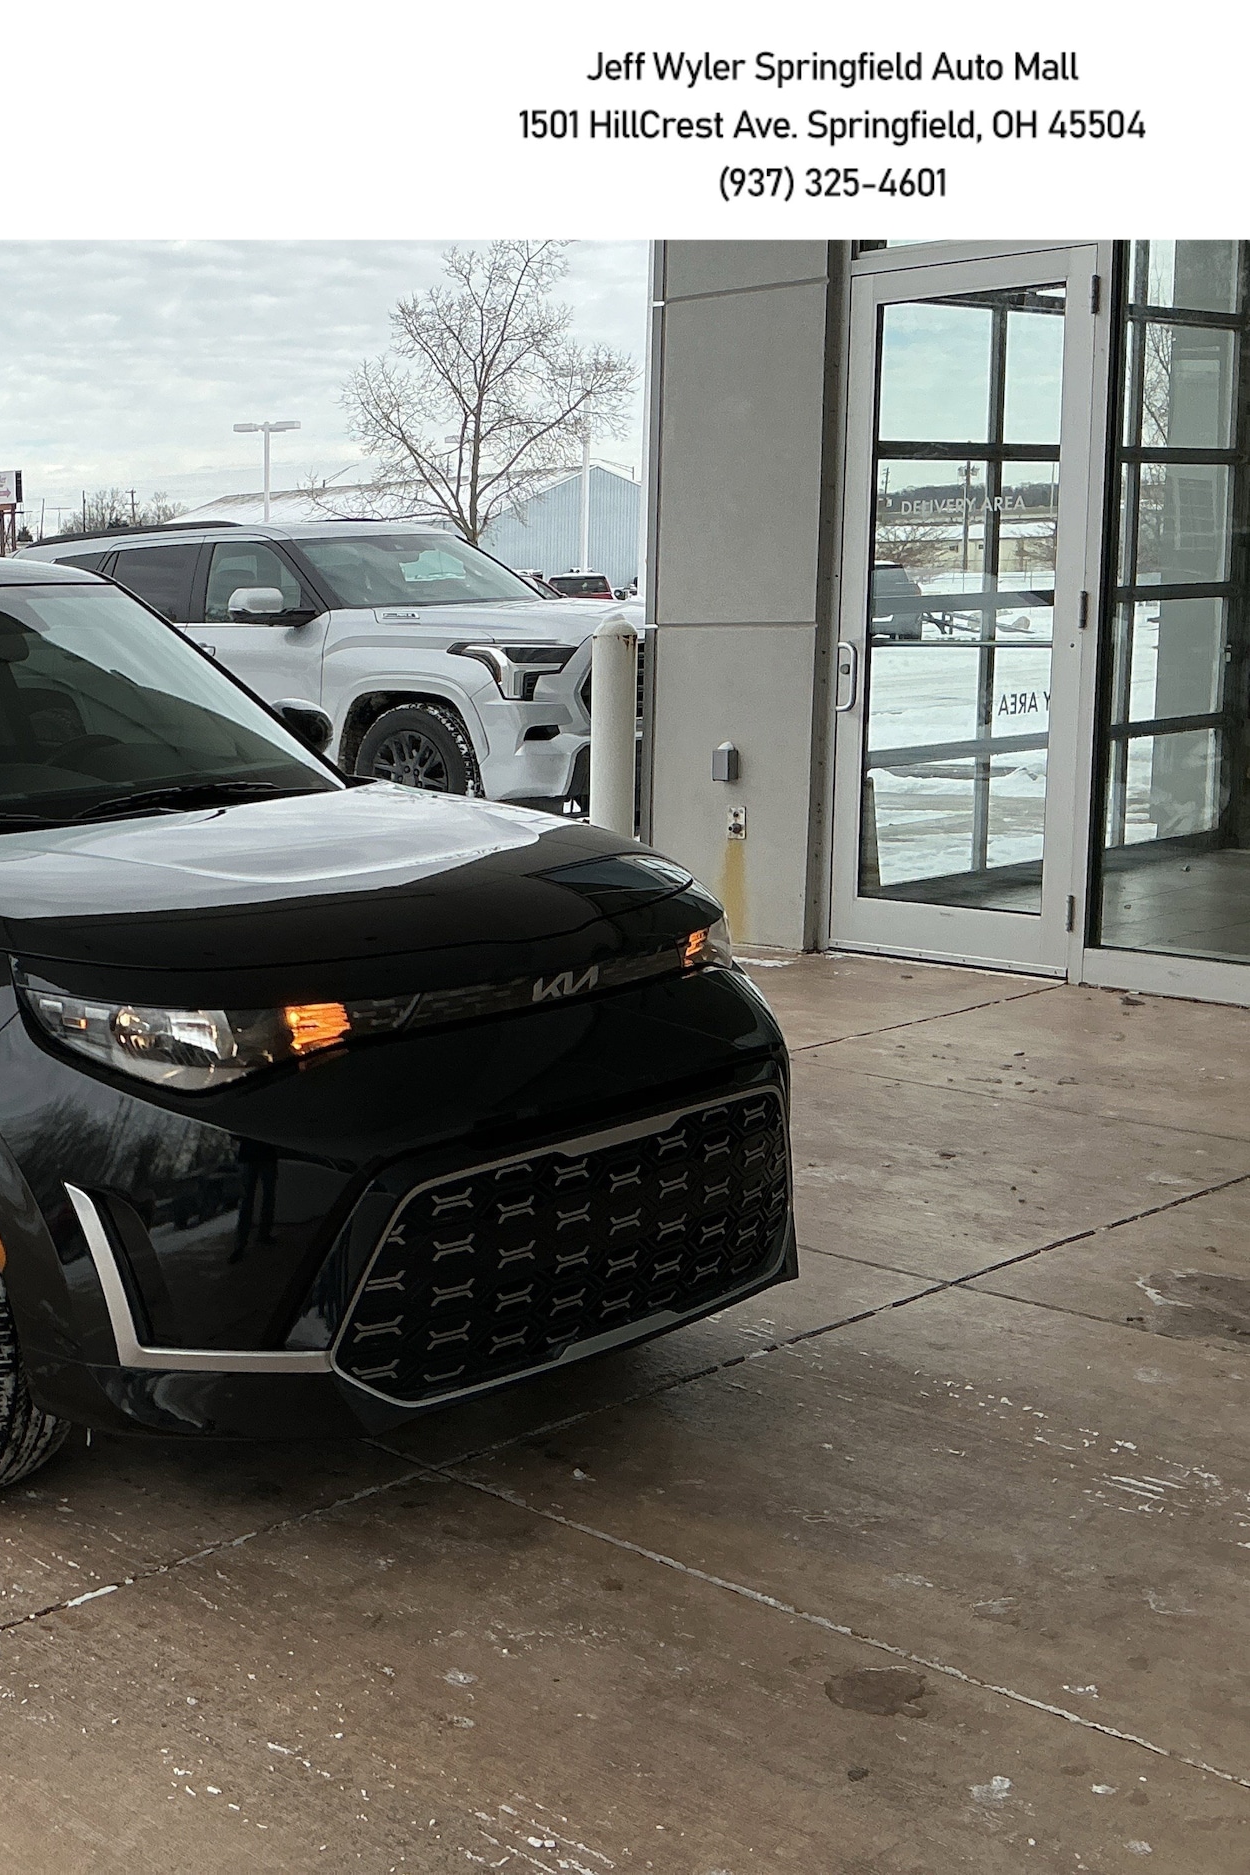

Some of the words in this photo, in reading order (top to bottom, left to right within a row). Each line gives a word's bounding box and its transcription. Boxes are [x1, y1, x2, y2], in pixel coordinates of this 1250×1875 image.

[901, 497, 976, 516] DELIVERY
[981, 495, 1026, 512] AREA
[532, 965, 599, 1002] KIA
